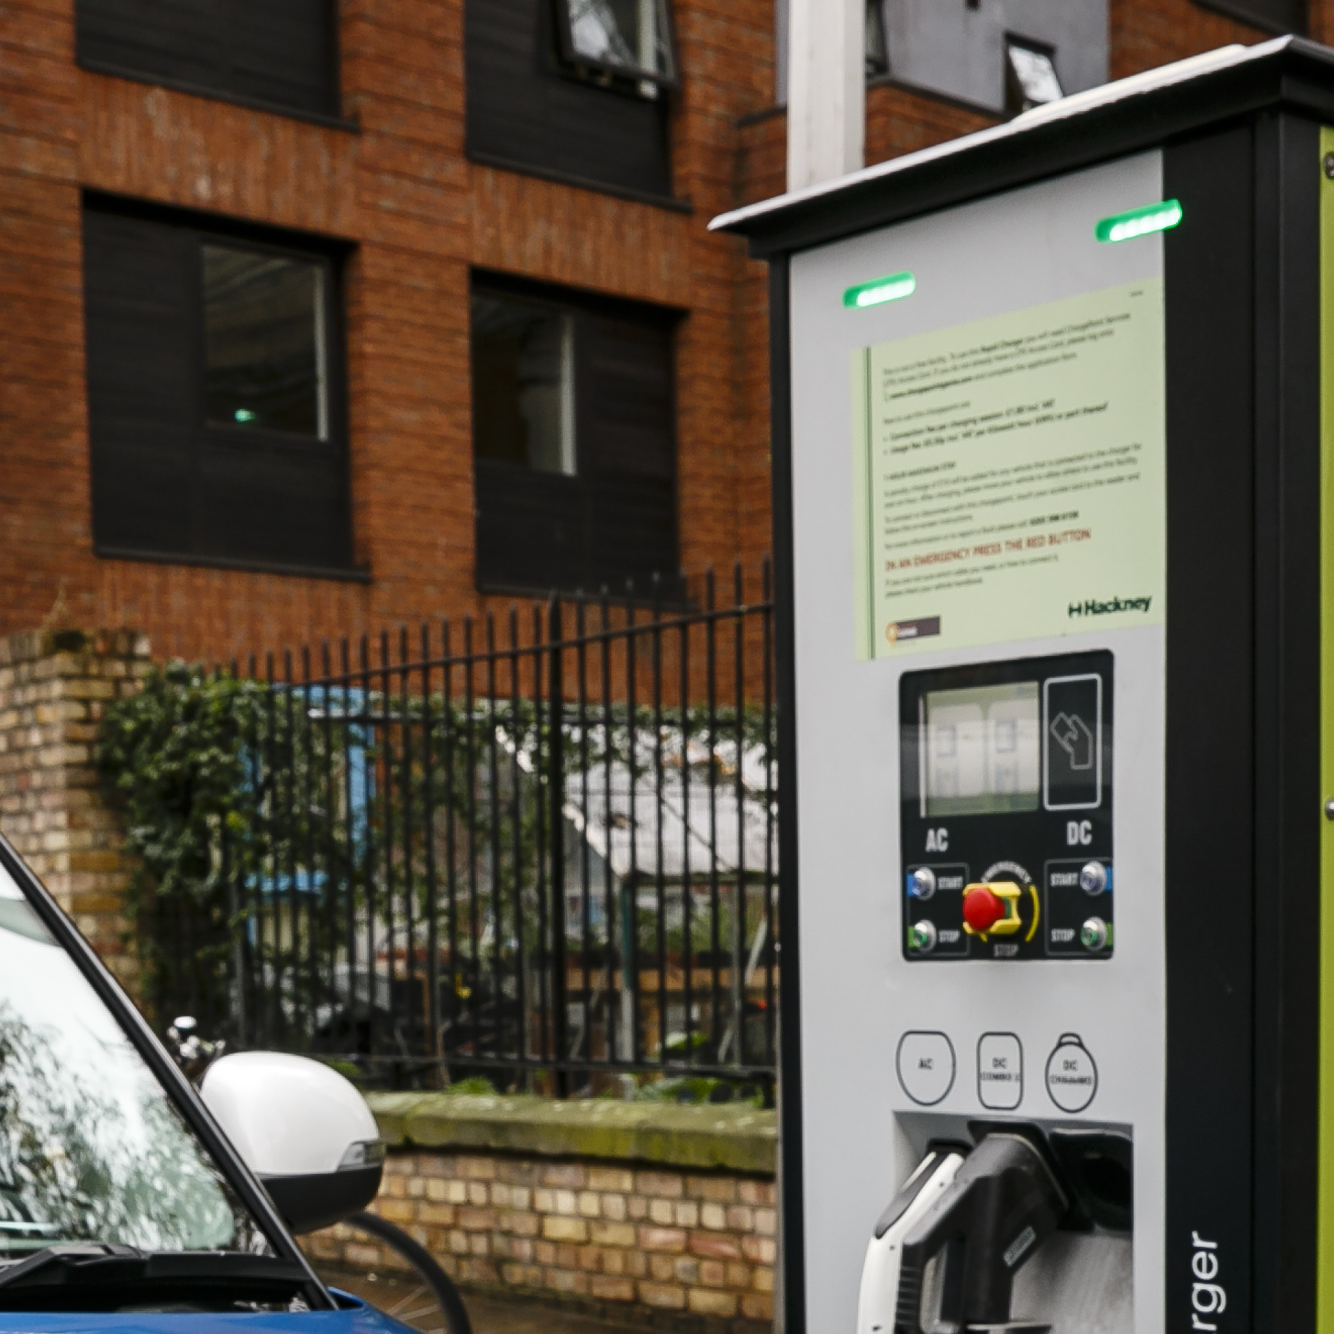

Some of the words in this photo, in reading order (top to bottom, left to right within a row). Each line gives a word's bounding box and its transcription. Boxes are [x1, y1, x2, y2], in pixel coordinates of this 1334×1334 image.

[1085, 596, 1152, 616] Hackney
[926, 828, 948, 852] AC
[1067, 820, 1092, 845] DC
[918, 1058, 933, 1070] AC
[992, 1057, 1007, 1069] DC
[1063, 1060, 1078, 1071] DC
